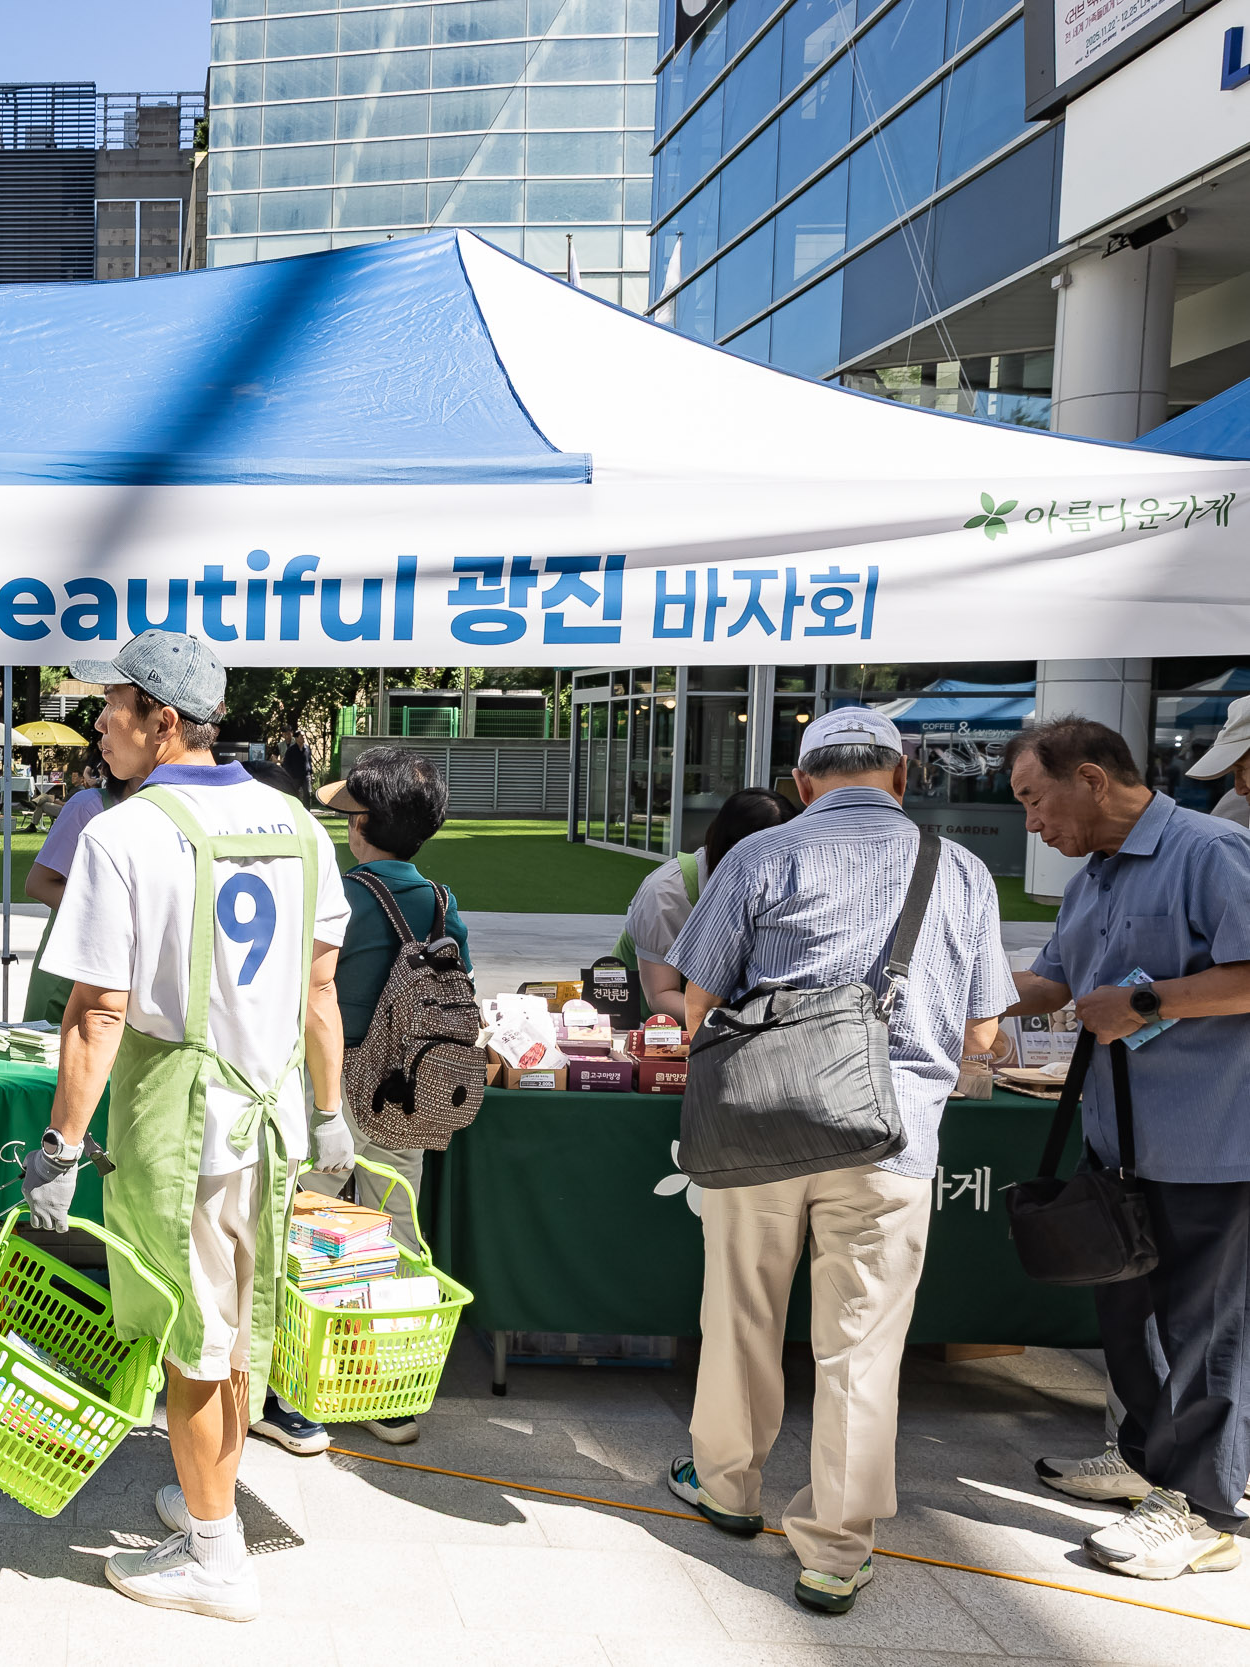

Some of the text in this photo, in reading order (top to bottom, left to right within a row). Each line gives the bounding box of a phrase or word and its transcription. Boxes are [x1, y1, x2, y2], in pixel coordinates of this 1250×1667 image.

[1024, 492, 1237, 533] 아름다운가게
[448, 554, 628, 646] 광진
[652, 565, 880, 643] 바자회
[922, 722, 955, 730] COFFEE
[946, 825, 999, 835] GARDEN
[216, 872, 277, 986] 9
[593, 988, 630, 1002] 견과류바
[590, 1072, 621, 1081] 고구마양갱
